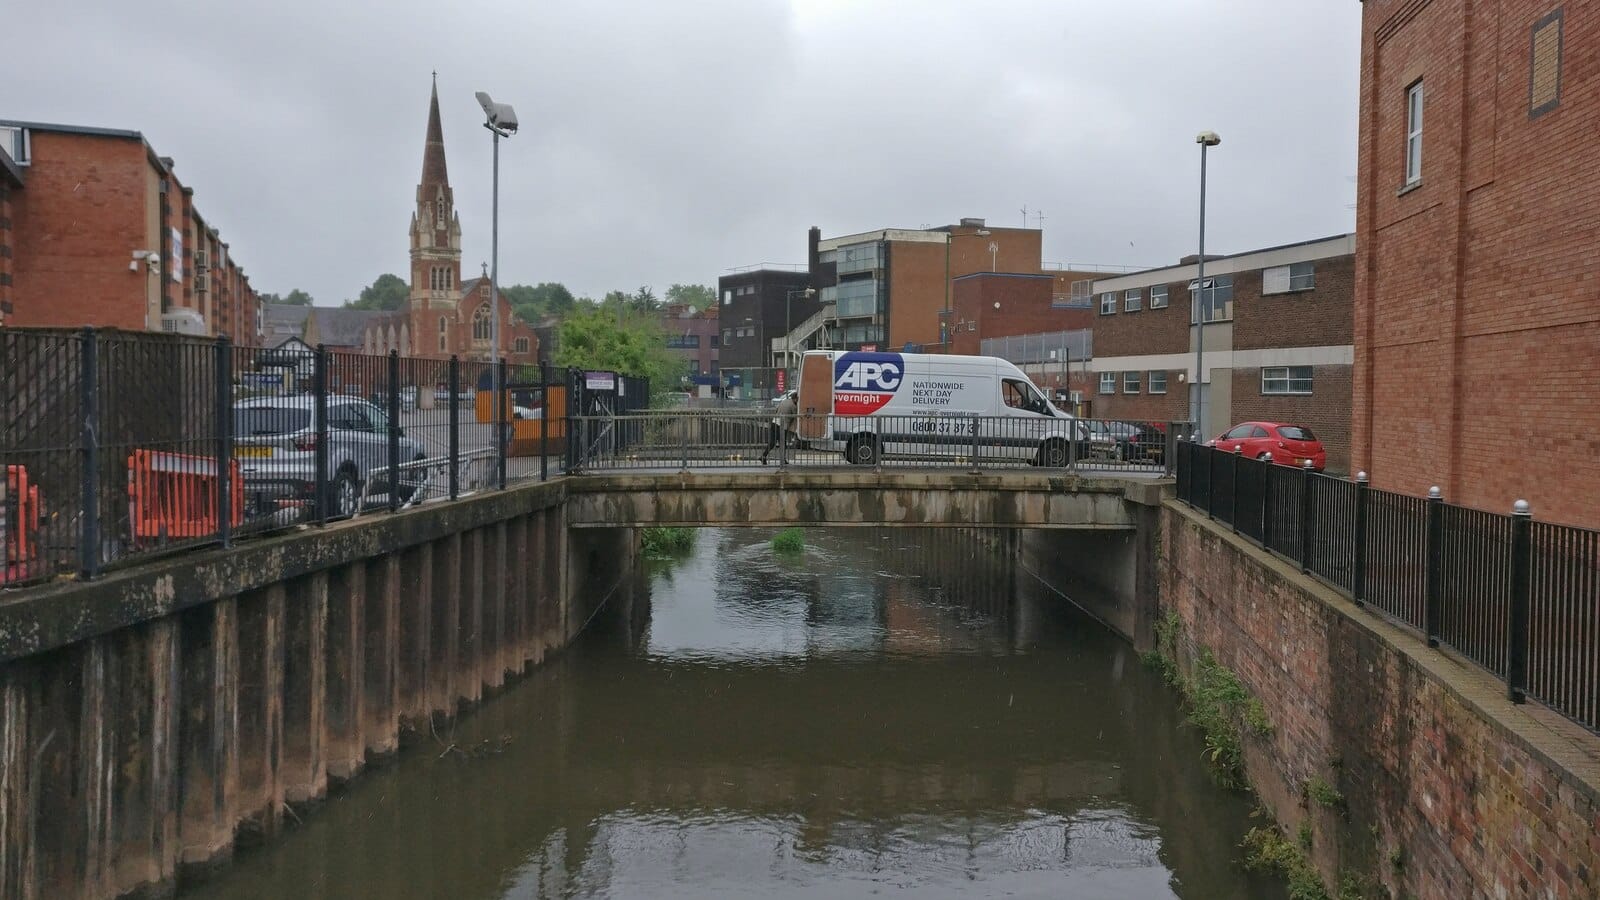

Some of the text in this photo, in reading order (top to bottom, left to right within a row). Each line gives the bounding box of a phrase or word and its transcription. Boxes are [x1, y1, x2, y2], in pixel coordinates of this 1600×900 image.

[835, 362, 900, 390] APC
[913, 381, 965, 390] NATIONWIDE
[912, 389, 953, 398] NEXT DAY
[912, 397, 951, 405] DELIVERY
[912, 421, 937, 432] 0800
[938, 422, 950, 433] 37
